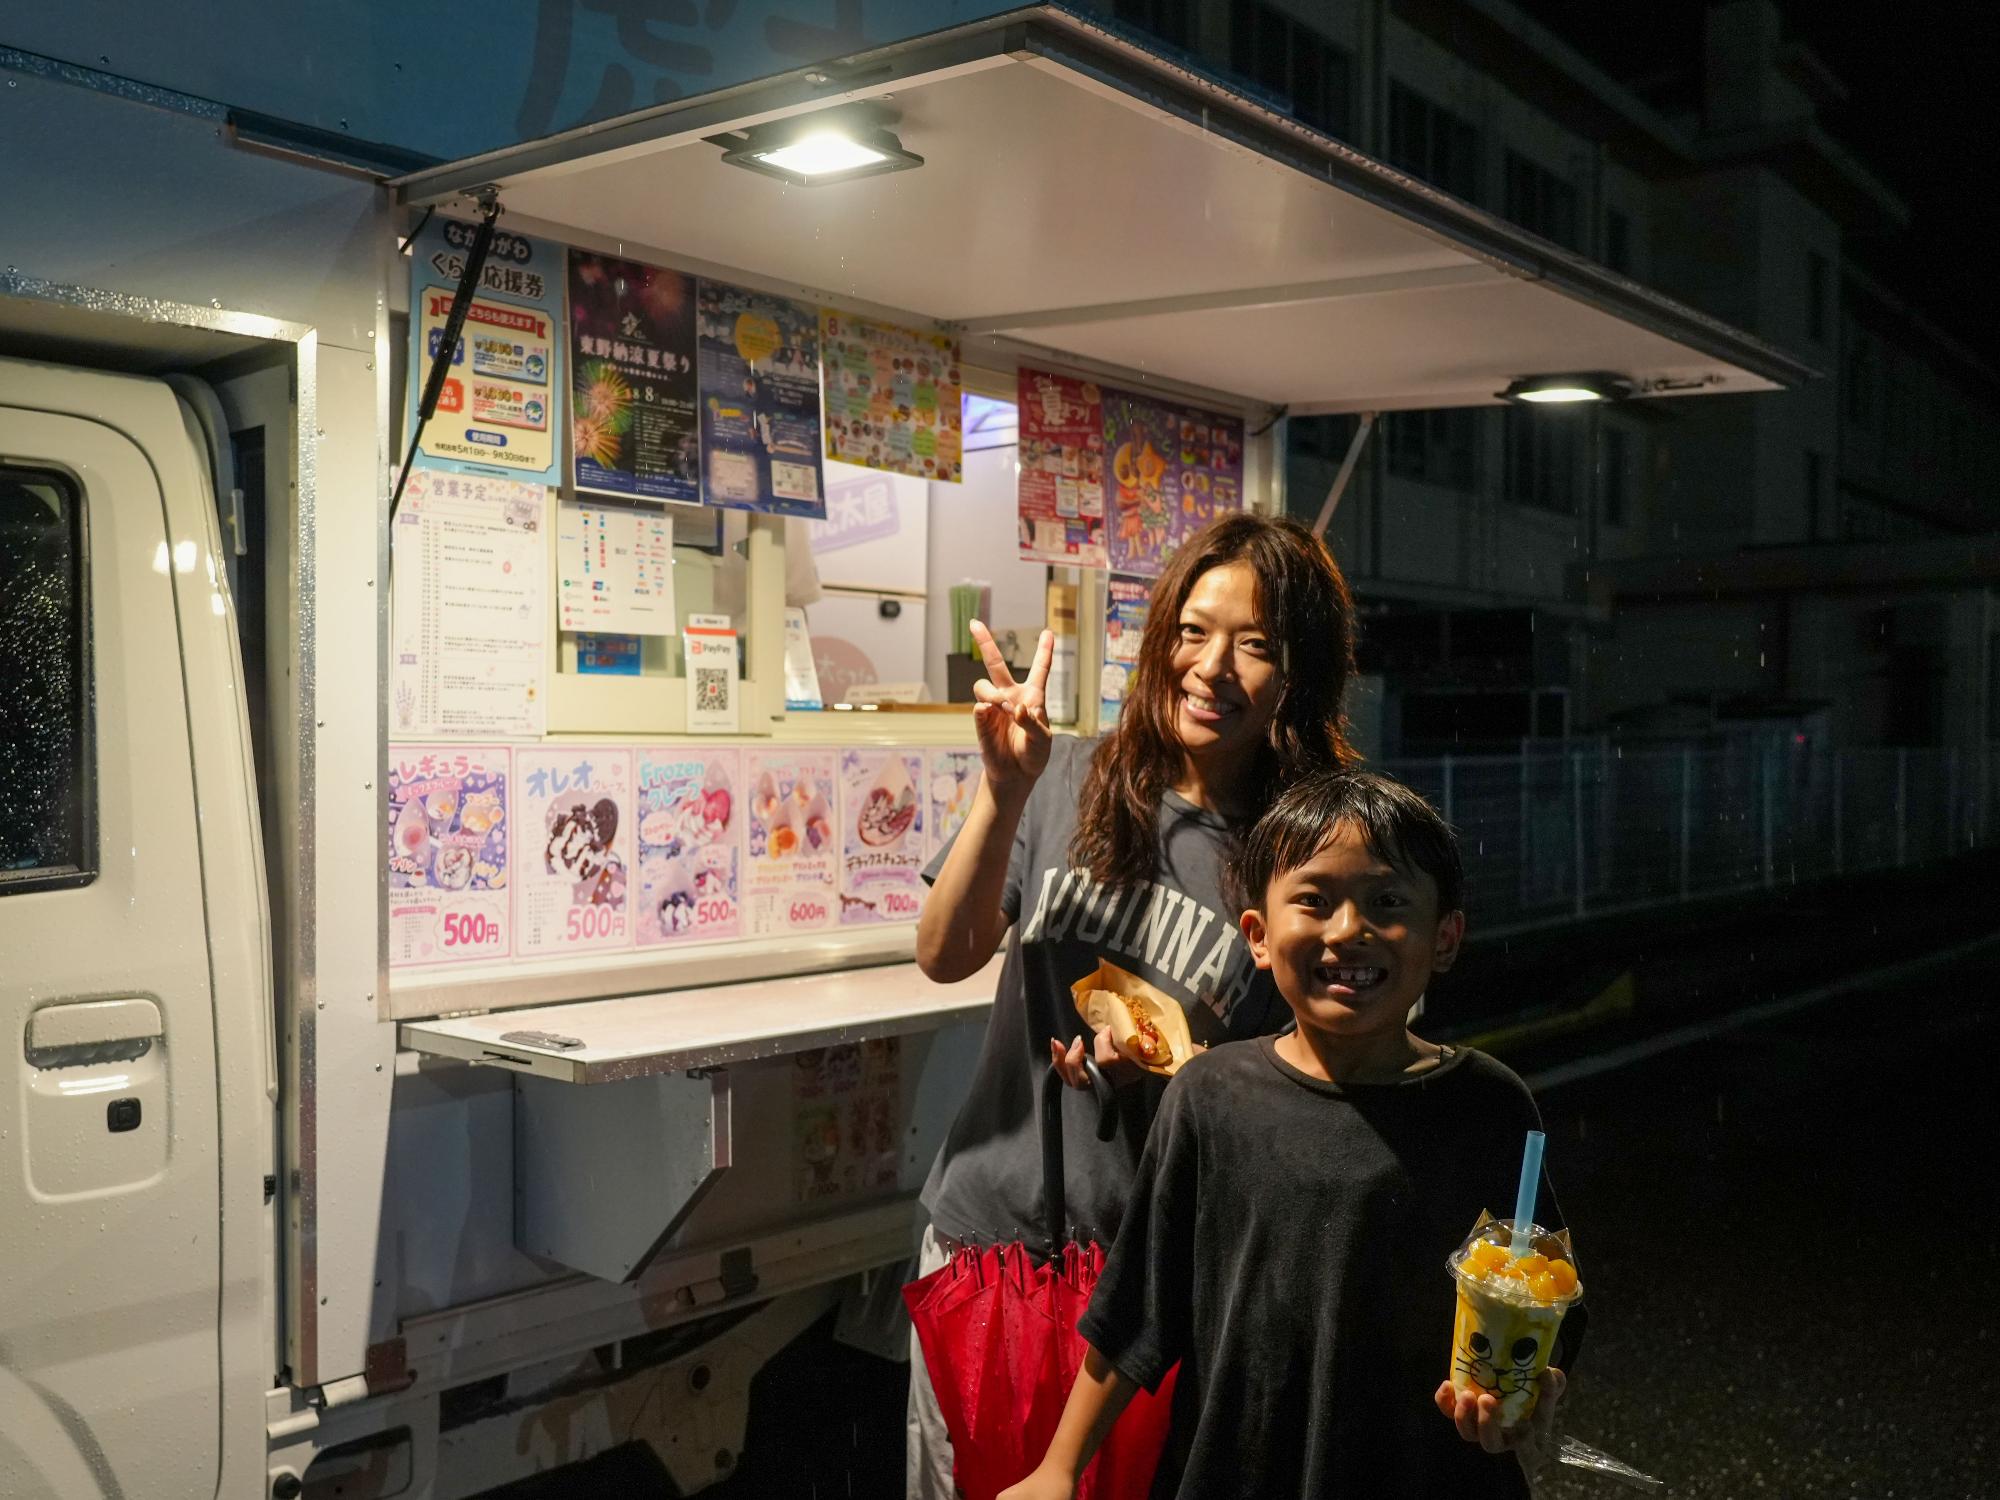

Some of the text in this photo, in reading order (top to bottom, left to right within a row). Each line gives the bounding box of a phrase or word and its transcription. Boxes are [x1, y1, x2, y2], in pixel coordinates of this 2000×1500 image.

[432, 253, 543, 298] くら応援券
[432, 478, 486, 501] 営業予定
[703, 643, 731, 655] PayPay
[399, 754, 485, 781] レギュラー
[526, 760, 593, 797] オレオ
[640, 761, 704, 787] Frozen
[790, 902, 825, 922] 600円
[885, 894, 919, 912] 700円
[444, 912, 498, 947] 500円
[567, 906, 625, 941] 500円
